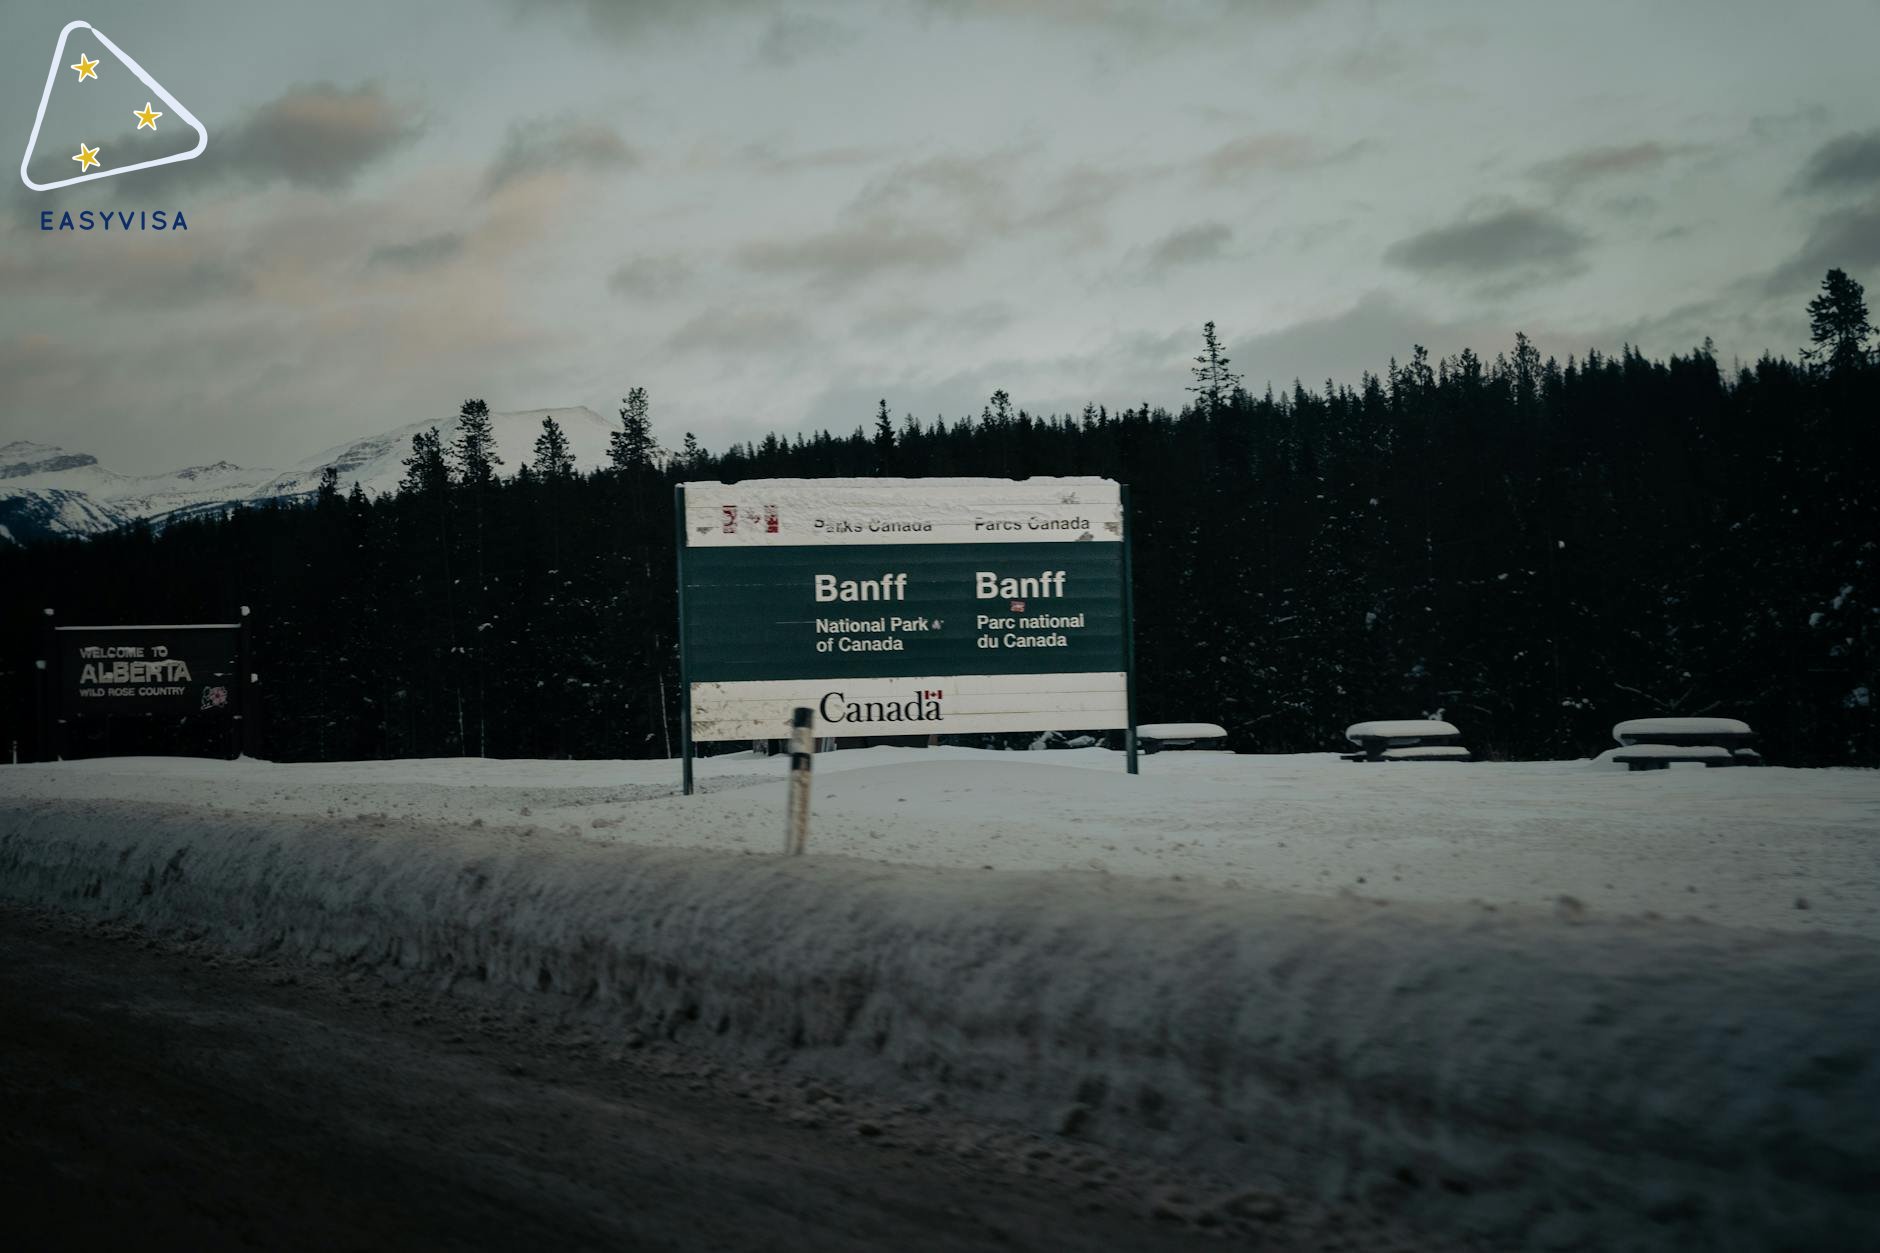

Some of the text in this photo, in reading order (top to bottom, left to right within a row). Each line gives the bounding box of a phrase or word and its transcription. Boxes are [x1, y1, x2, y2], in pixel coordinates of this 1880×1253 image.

[975, 516, 1090, 531] Parcs Canada
[815, 573, 907, 602] Banff
[976, 570, 1067, 599] Banff
[816, 616, 929, 634] National Park
[976, 612, 1085, 630] Parc national
[816, 636, 904, 653] of Canada
[977, 632, 1068, 649] du Canada
[79, 645, 168, 659] WELCOME TO
[79, 659, 192, 684] ALBERTA
[79, 686, 186, 697] WILD ROSE COUNTRY
[819, 690, 944, 723] Canada
